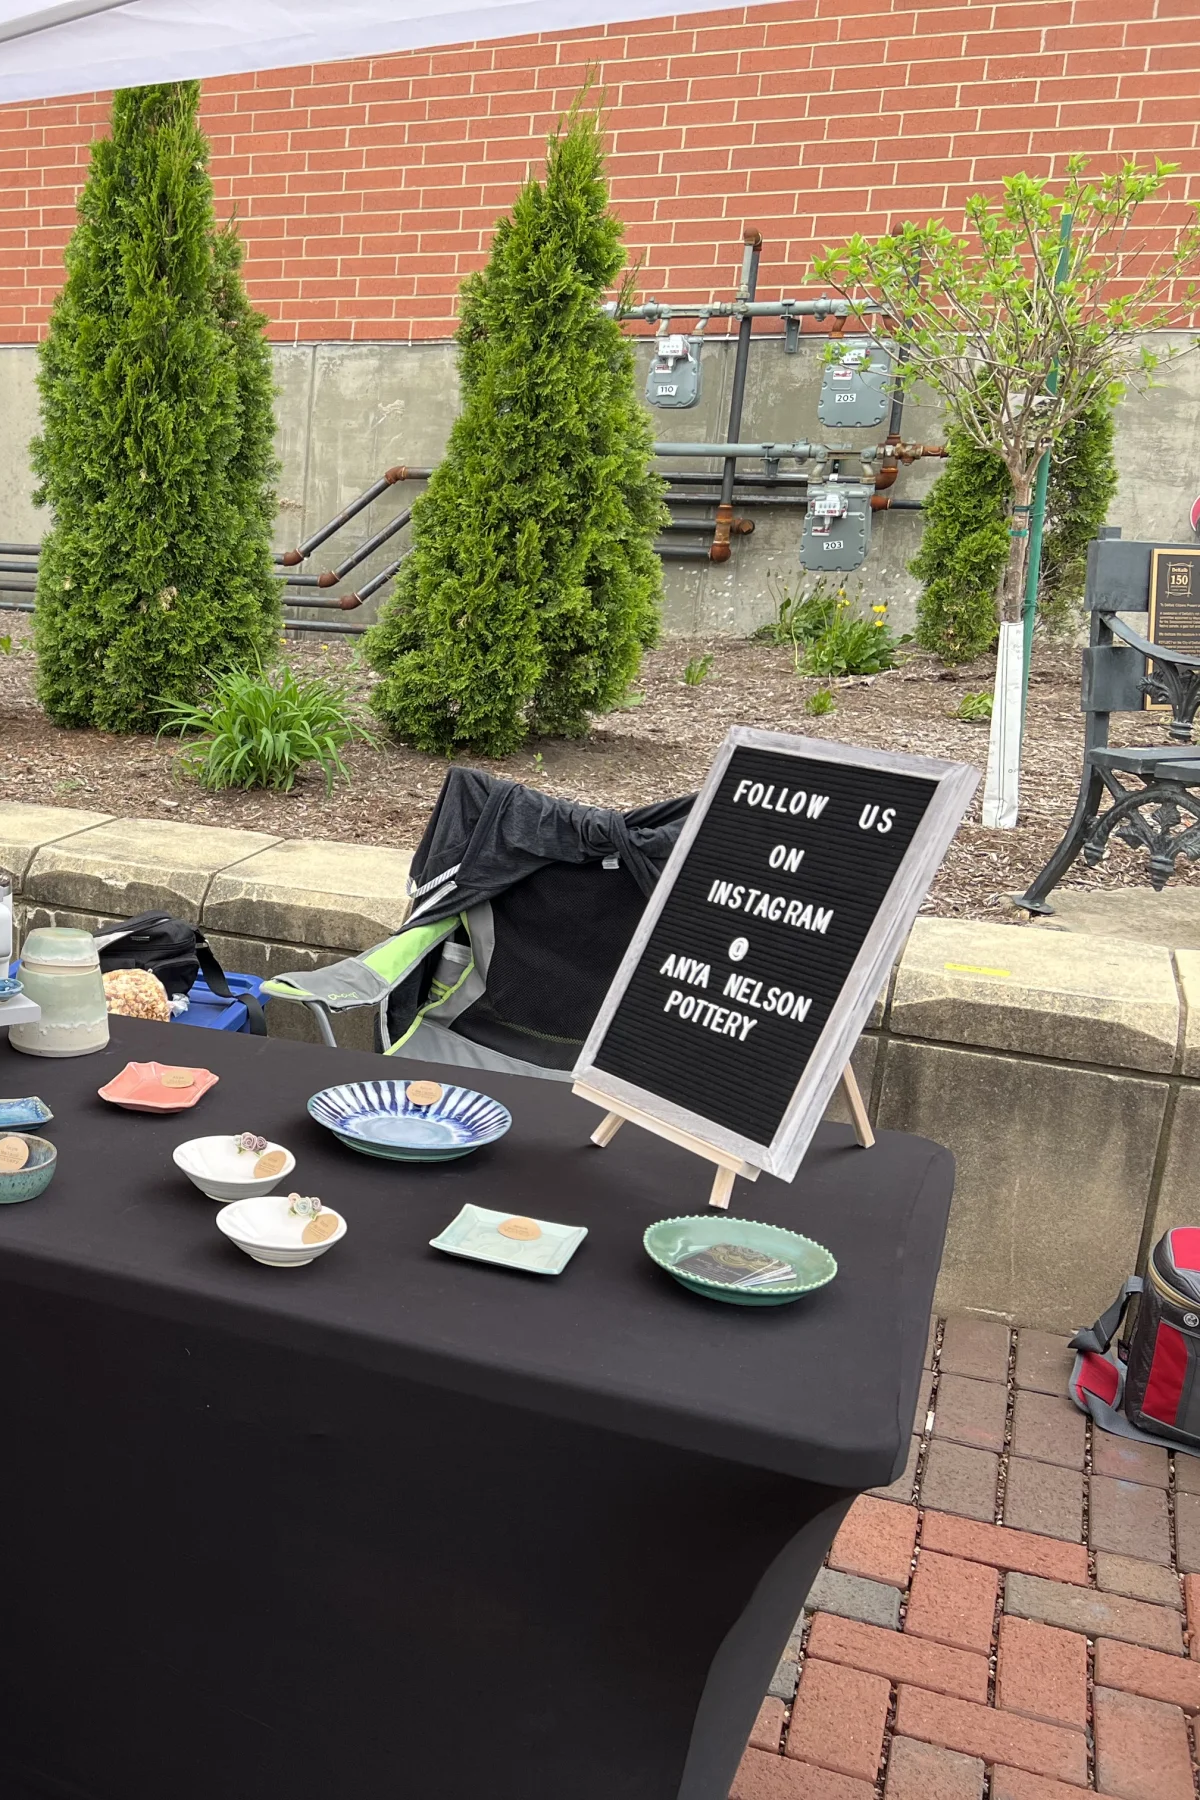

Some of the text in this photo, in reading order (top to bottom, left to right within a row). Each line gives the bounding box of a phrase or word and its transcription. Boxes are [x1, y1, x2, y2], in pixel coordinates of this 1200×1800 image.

[837, 394, 855, 402] 205
[825, 541, 842, 550] 203
[1171, 575, 1188, 585] 150
[733, 779, 896, 833] FOLLOW US
[768, 844, 805, 873] ON
[707, 879, 834, 934] INSTAGRAM
[728, 937, 749, 962] @
[659, 954, 813, 1022] ANYA NELSON
[663, 990, 758, 1042] POTTERY
